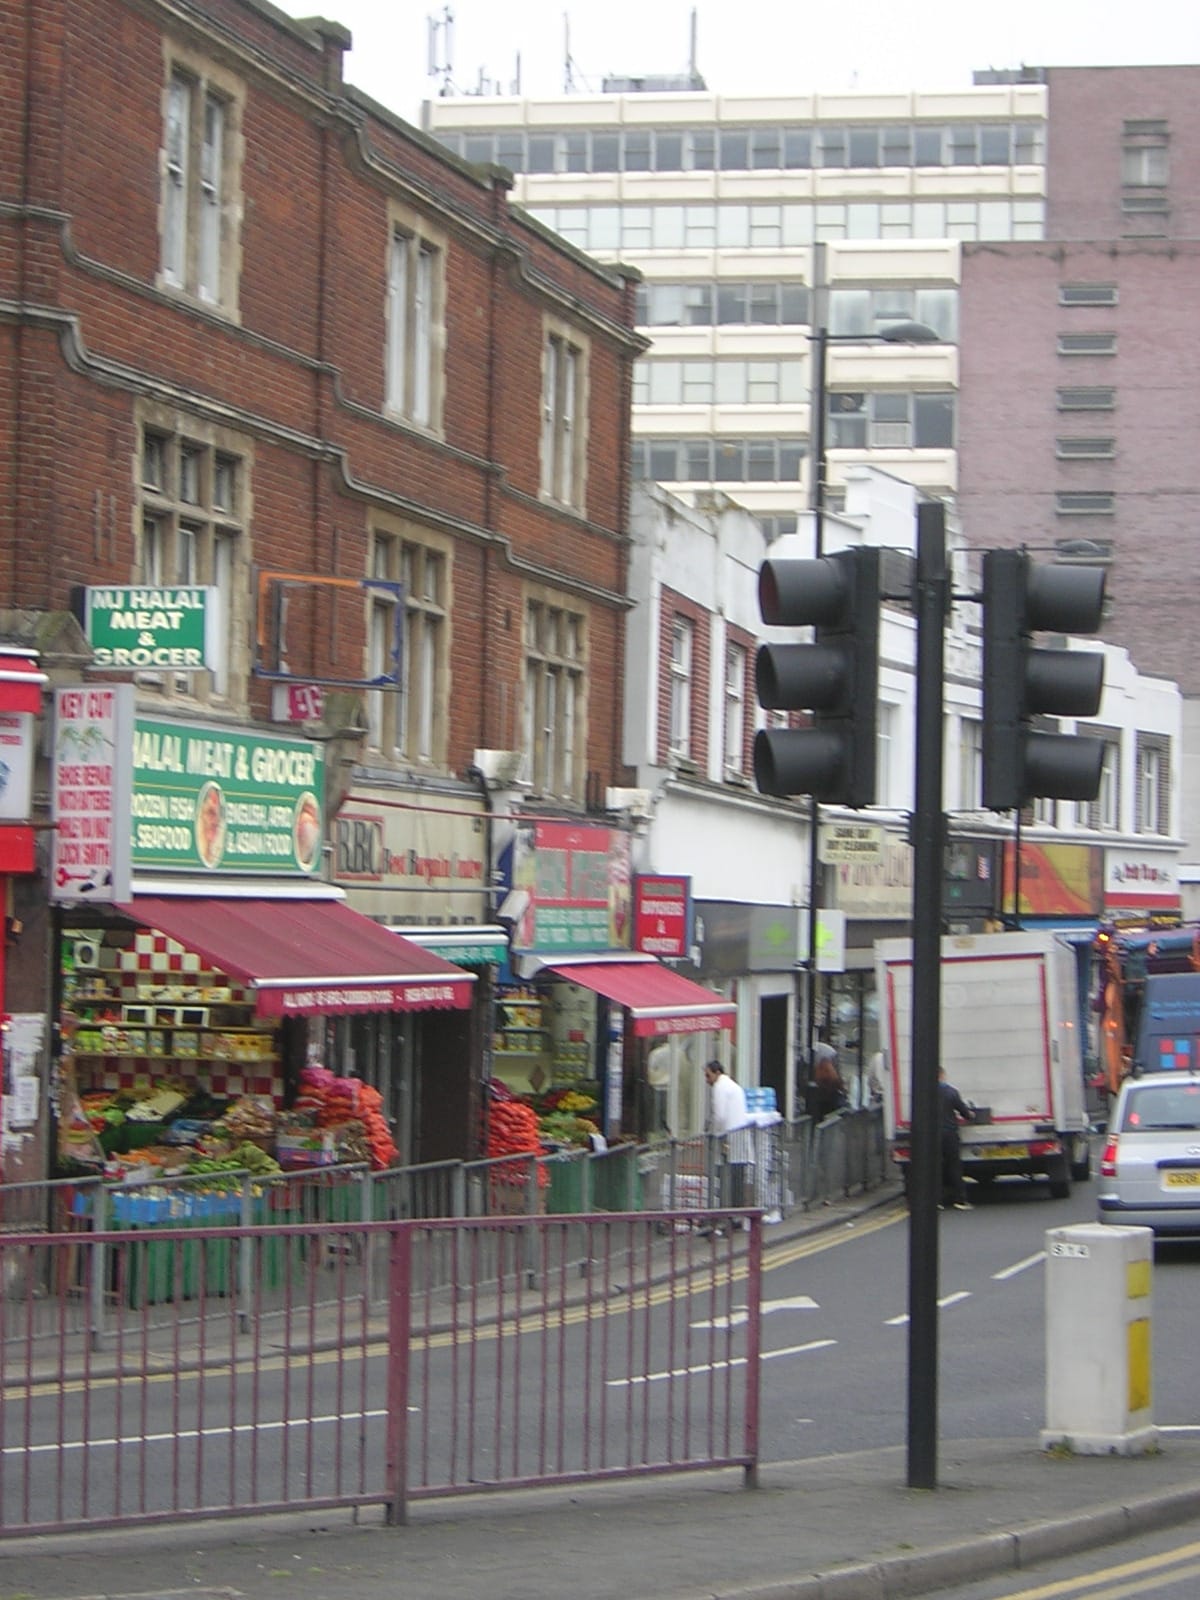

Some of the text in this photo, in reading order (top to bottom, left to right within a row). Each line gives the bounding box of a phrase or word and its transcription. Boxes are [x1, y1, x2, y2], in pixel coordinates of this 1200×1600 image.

[129, 590, 204, 610] HALAL
[110, 611, 184, 630] MEAT
[137, 631, 157, 646] &
[93, 647, 202, 666] GROCER
[59, 691, 113, 719] KEY CUT
[186, 738, 234, 778] MEAT
[234, 745, 250, 780] &
[251, 746, 316, 786] GROCER
[169, 796, 195, 822] FISH
[137, 823, 192, 850] SEAFOOD
[264, 834, 292, 855] FOOD
